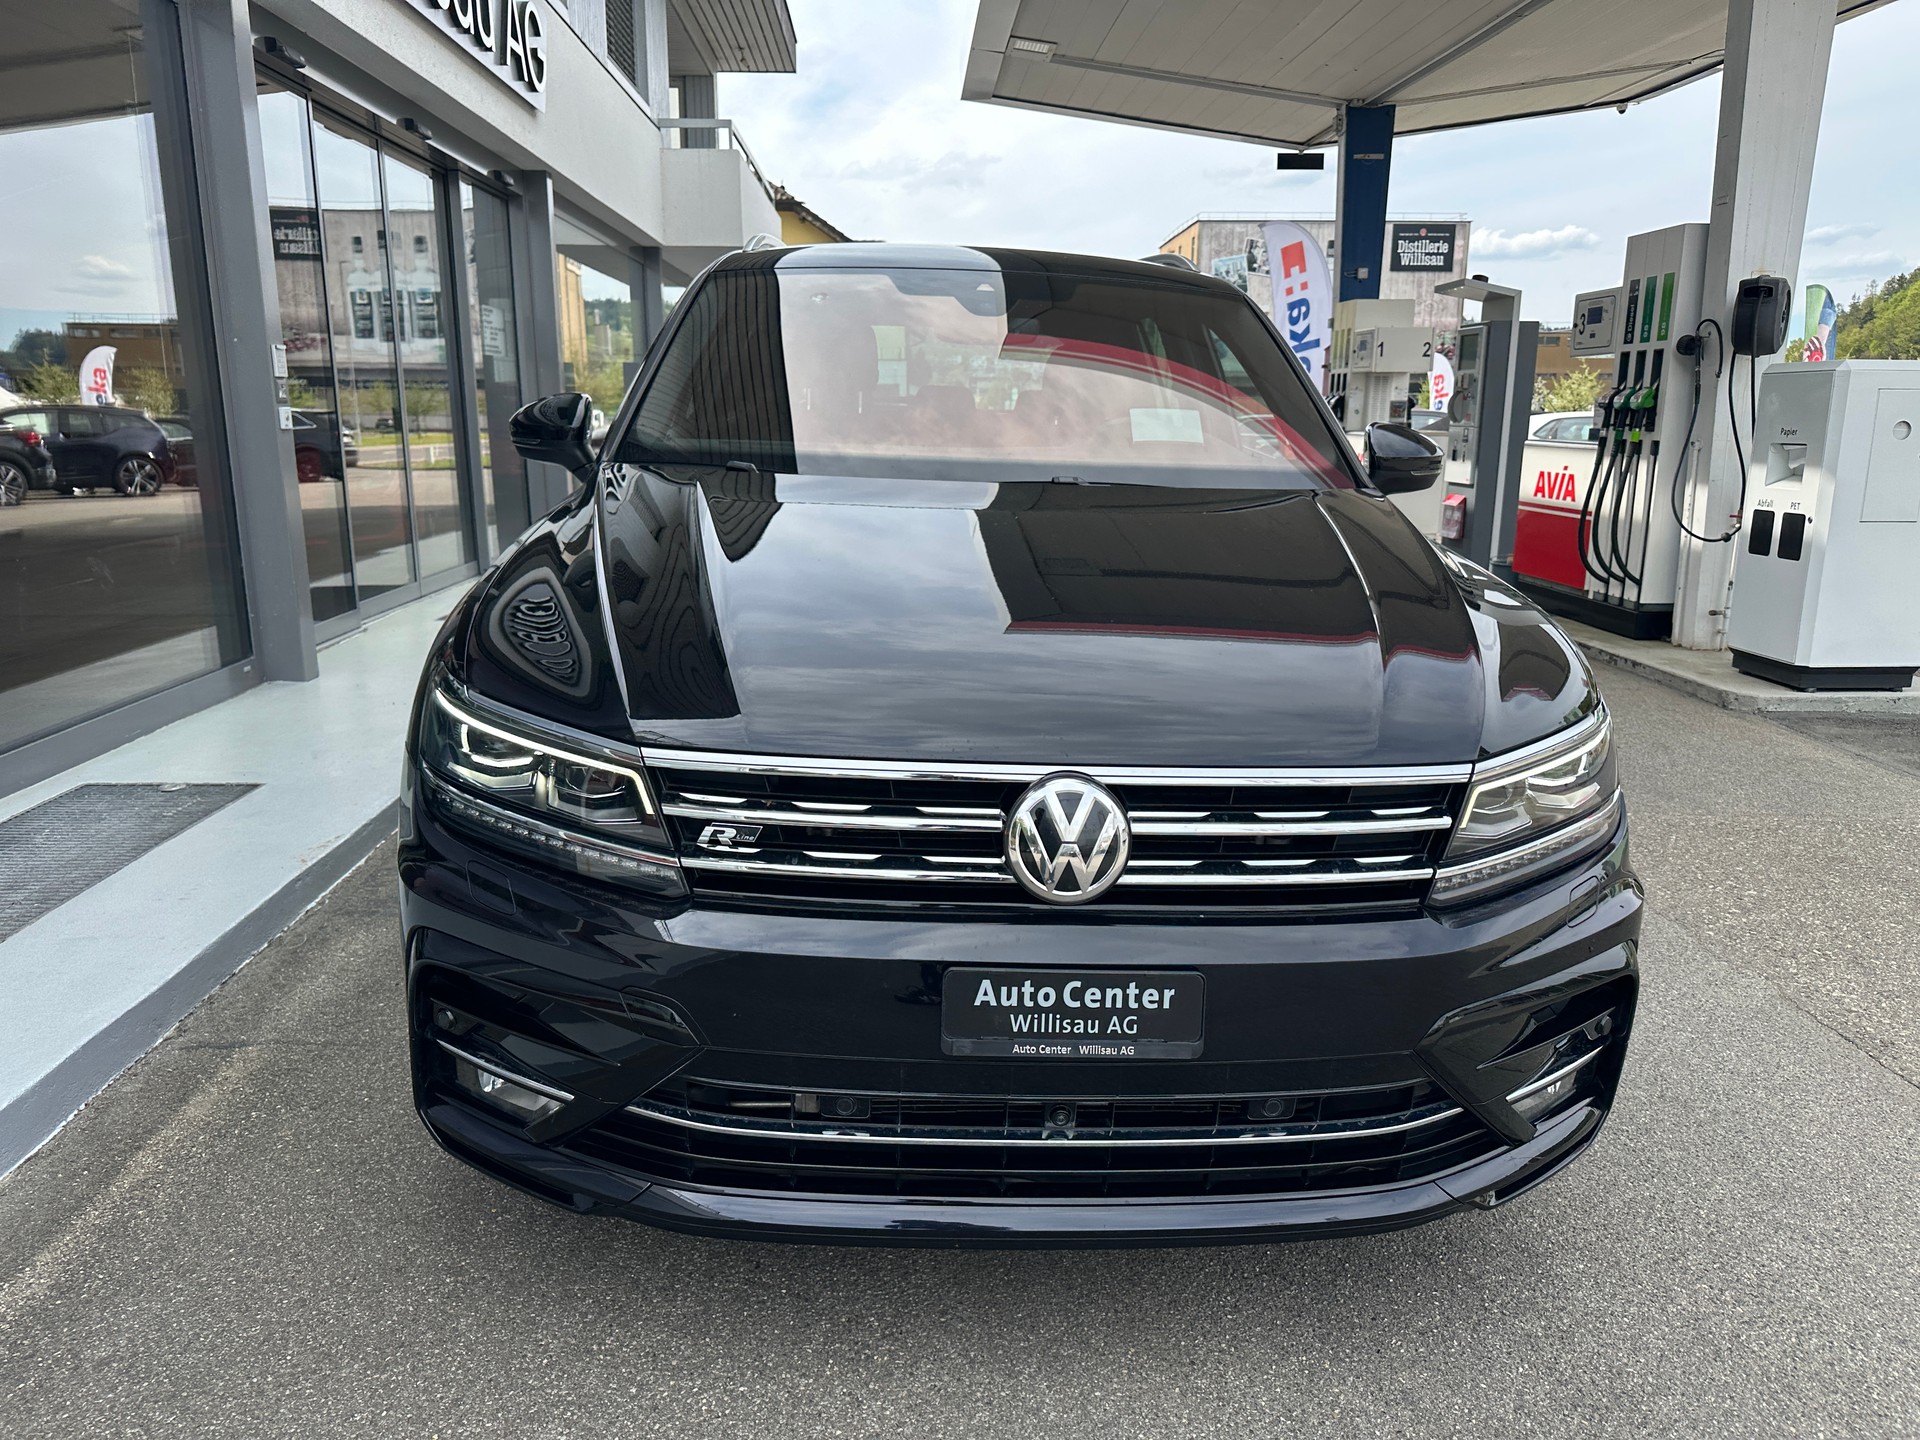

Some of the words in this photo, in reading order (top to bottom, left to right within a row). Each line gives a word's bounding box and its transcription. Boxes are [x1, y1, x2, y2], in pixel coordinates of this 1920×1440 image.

[506, 0, 547, 93] AG
[1397, 240, 1449, 253] Distillerie
[1400, 253, 1444, 266] Willisau
[1578, 313, 1586, 335] 3
[1378, 341, 1384, 357] 1
[1422, 342, 1431, 357] 2
[1780, 427, 1798, 438] Papier
[1757, 499, 1774, 508] Abfall
[1790, 501, 1801, 510] PET
[697, 826, 737, 845] R
[974, 979, 1056, 1007] Auto
[1063, 980, 1176, 1010] Center
[1010, 1014, 1099, 1034] Willisau
[1106, 1015, 1138, 1035] AG
[1012, 1044, 1036, 1055] Auto
[1039, 1044, 1072, 1055] Center
[1079, 1045, 1117, 1056] Willisau
[1119, 1046, 1135, 1056] AG
